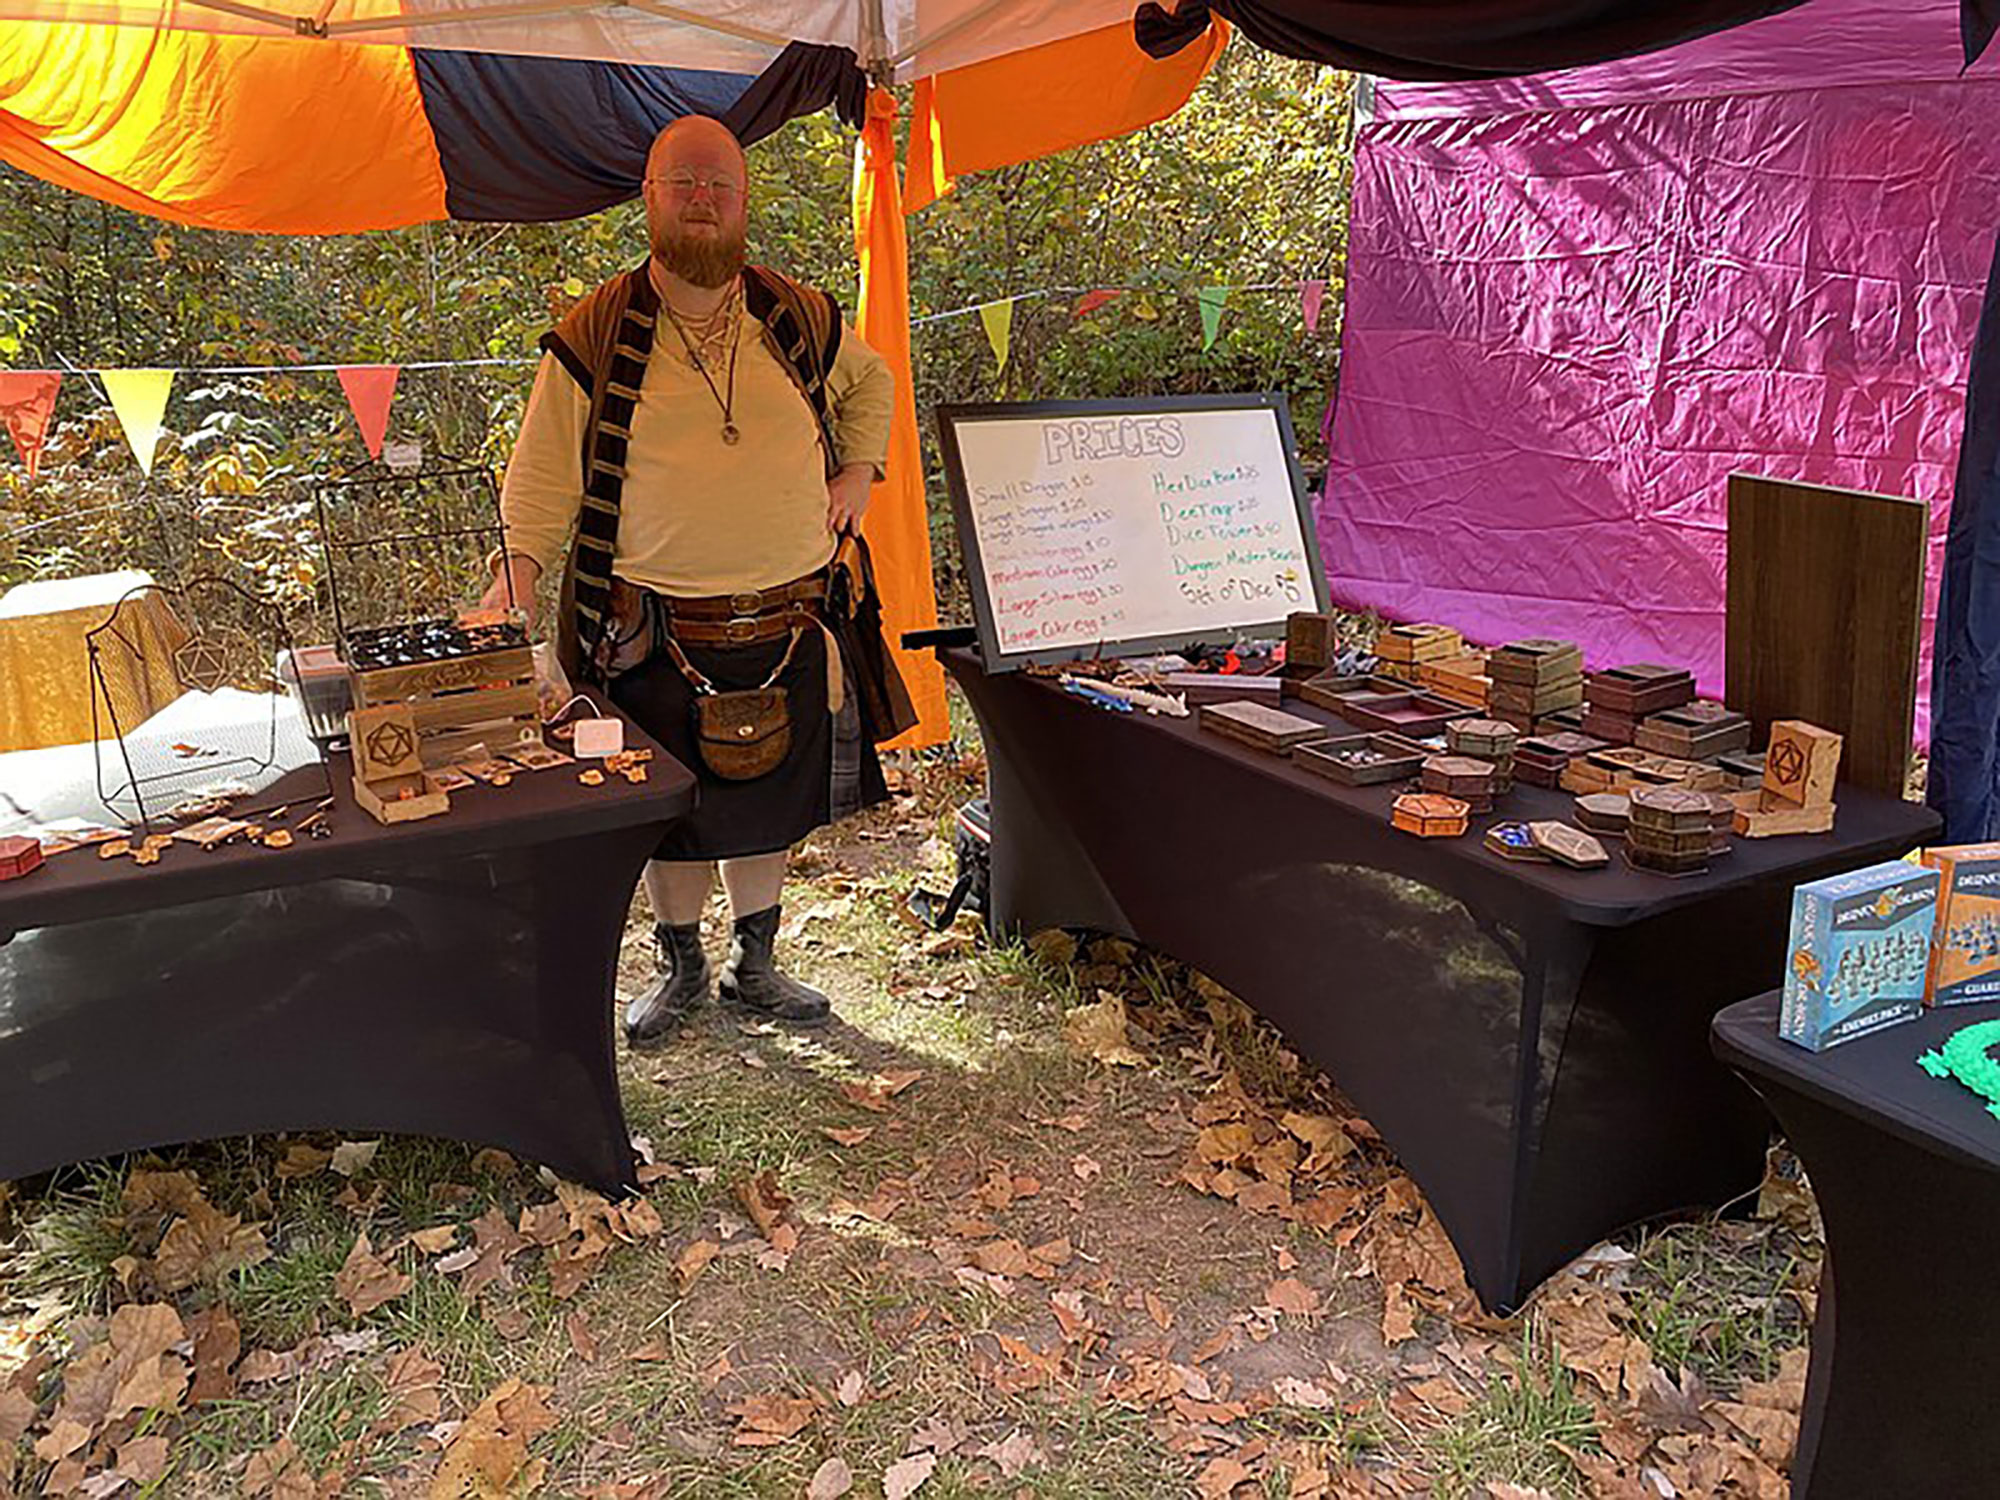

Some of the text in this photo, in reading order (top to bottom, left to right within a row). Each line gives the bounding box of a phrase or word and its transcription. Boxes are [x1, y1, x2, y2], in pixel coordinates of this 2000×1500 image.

[1043, 417, 1185, 465] PRICES
[975, 482, 1018, 506] Small
[1240, 579, 1274, 601] Dice
